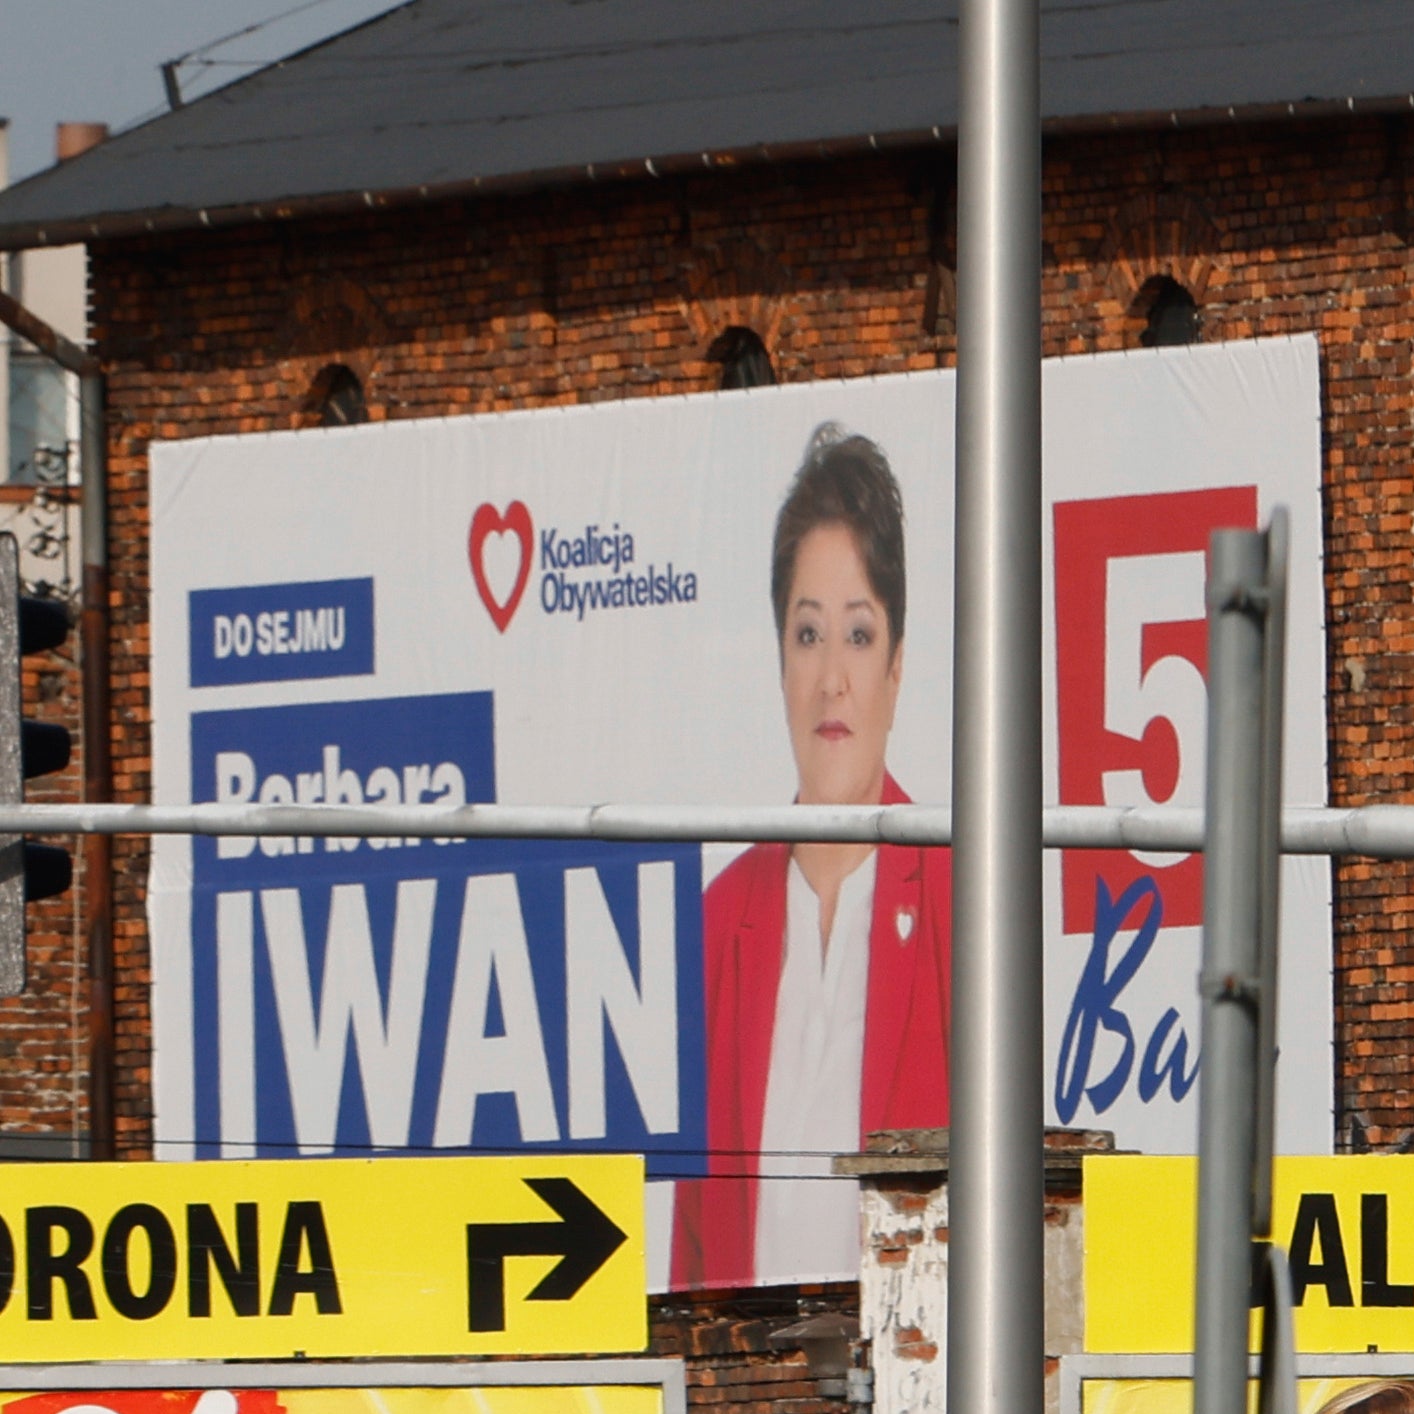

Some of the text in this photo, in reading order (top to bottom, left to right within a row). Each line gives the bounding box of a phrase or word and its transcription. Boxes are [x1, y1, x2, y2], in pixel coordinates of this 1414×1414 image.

[541, 524, 634, 574] Koalicja
[541, 563, 697, 620] Obywatelska
[214, 606, 346, 659] DO SEJMU
[215, 744, 467, 859] Barbara
[215, 858, 682, 1160] IWAN
[1055, 873, 1200, 1125] Ba
[0, 1201, 343, 1321] RONA
